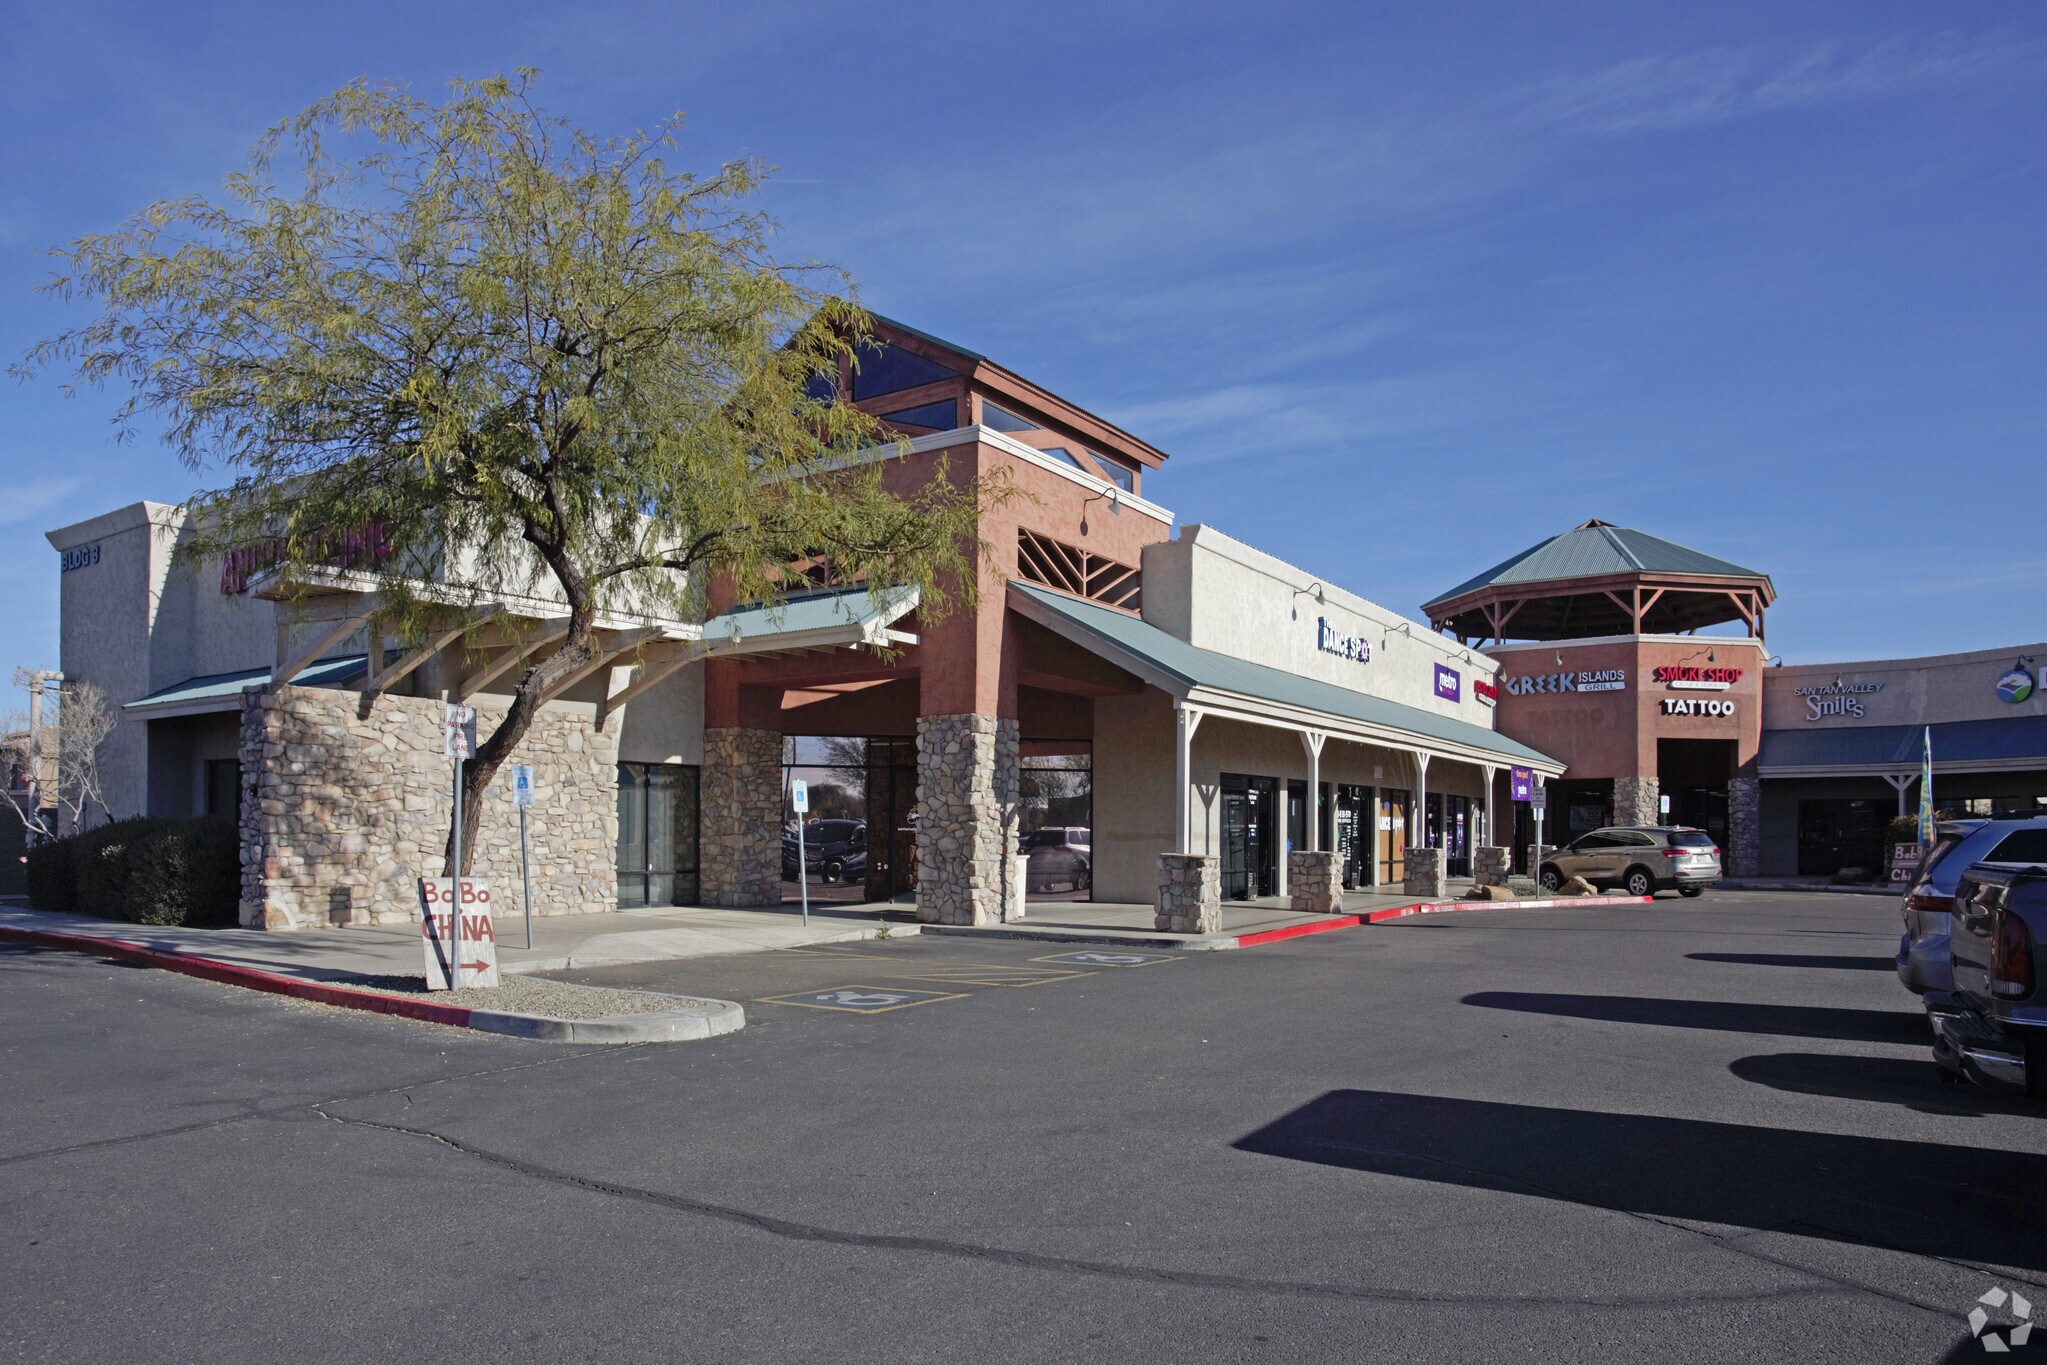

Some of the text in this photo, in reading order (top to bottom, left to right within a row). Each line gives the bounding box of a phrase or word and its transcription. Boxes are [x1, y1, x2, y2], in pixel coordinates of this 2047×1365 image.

[61, 546, 90, 572] BLDG
[1323, 627, 1373, 662] DANCE SPOT
[1439, 672, 1457, 692] metro
[1505, 672, 1576, 696] GREEK
[1578, 670, 1625, 683] ISLANDS
[1658, 666, 1744, 682] SMOKE SHOP
[1584, 683, 1617, 691] GRILL
[1794, 683, 1883, 696] SAN TAN VALLEY
[1665, 699, 1735, 715] TATTOO
[1806, 695, 1864, 720] Smiles
[447, 721, 475, 730] PARKING
[424, 882, 490, 904] BoBo
